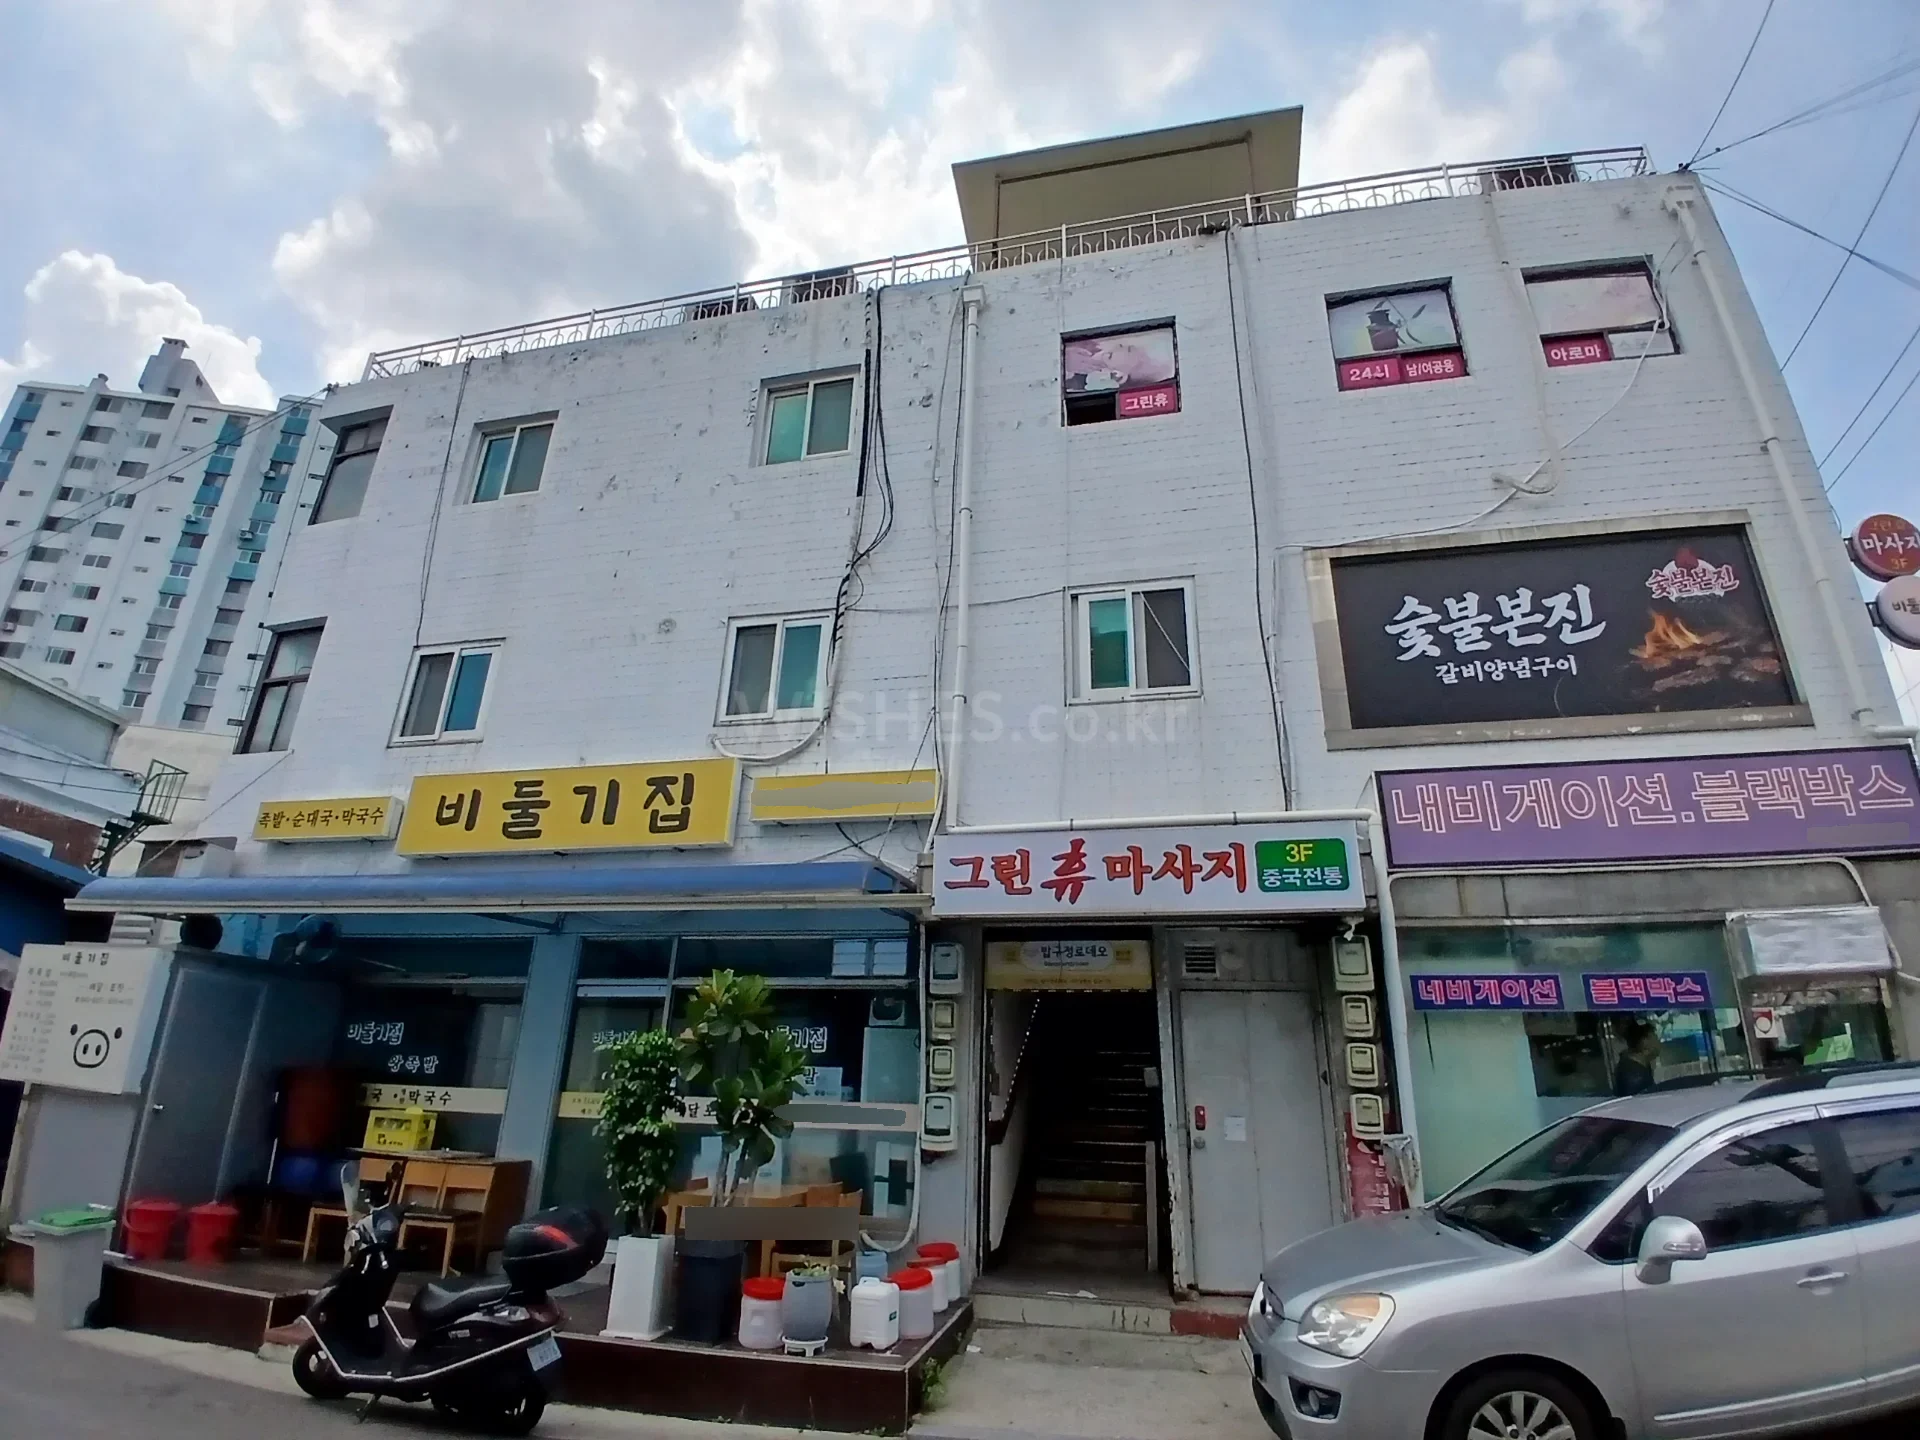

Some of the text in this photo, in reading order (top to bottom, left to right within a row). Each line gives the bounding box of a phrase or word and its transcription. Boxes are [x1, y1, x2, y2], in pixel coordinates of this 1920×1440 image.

[1550, 343, 1601, 363] 아로마
[1350, 363, 1390, 382] 24시
[1406, 359, 1455, 378] 남/여공용
[1125, 393, 1168, 410] 그린휴
[1646, 564, 1739, 598] 숯불본진
[1384, 584, 1606, 660] 숯불본진
[1435, 655, 1578, 684] 갈비양념구이
[436, 772, 694, 840] 비둘기집
[1285, 843, 1313, 863] 3F
[1102, 842, 1248, 896] 마사지
[1262, 865, 1343, 889] 중국전통
[62, 951, 109, 966] 비둘기집
[1418, 978, 1559, 1005] 네비게이션
[1590, 976, 1704, 1004] 블랙박스
[347, 1021, 405, 1045] 비둘기집
[388, 1054, 439, 1073] 왕족발
[409, 1090, 452, 1106] 막국수
